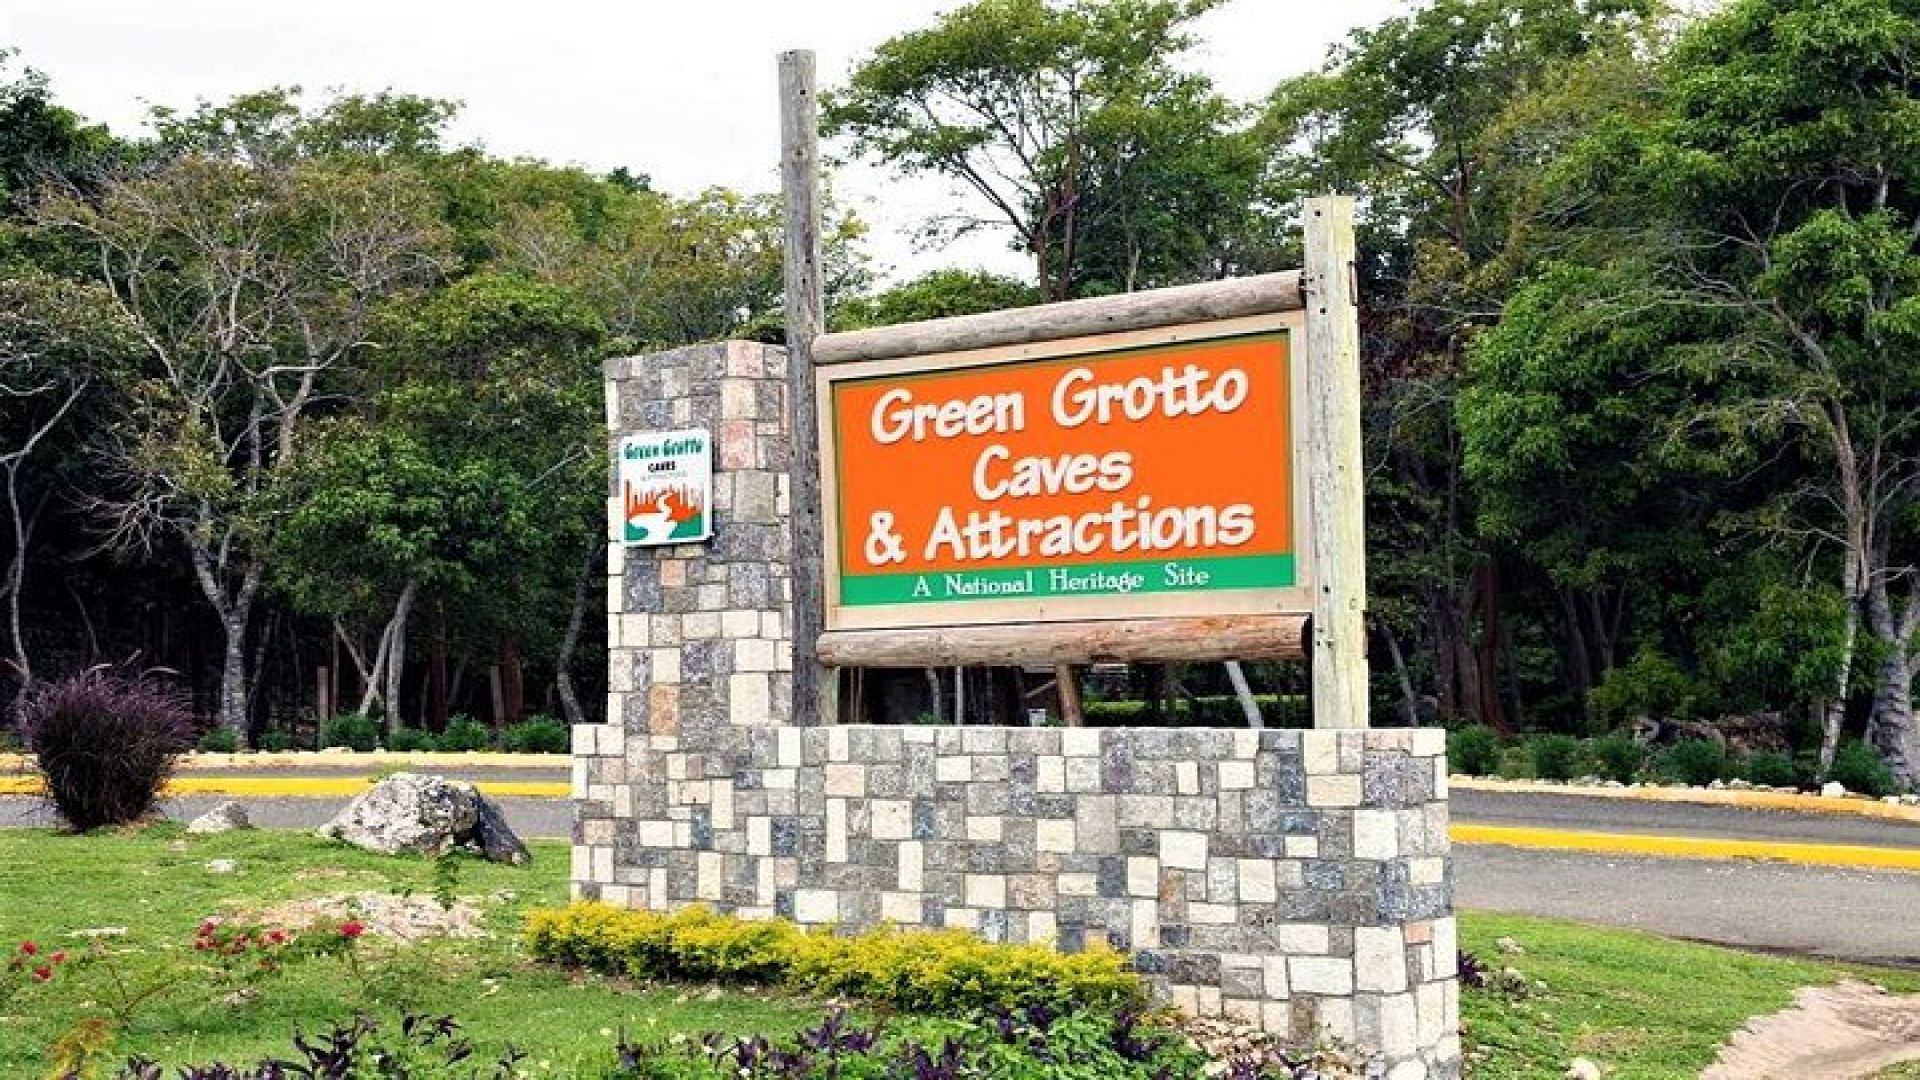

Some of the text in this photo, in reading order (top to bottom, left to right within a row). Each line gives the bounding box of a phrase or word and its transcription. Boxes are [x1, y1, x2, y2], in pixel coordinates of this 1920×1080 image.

[871, 364, 1249, 444] Green Grotto
[973, 444, 1134, 501] Caves
[865, 495, 1255, 566] & Attractions
[912, 562, 1210, 598] A National Heritage Site
